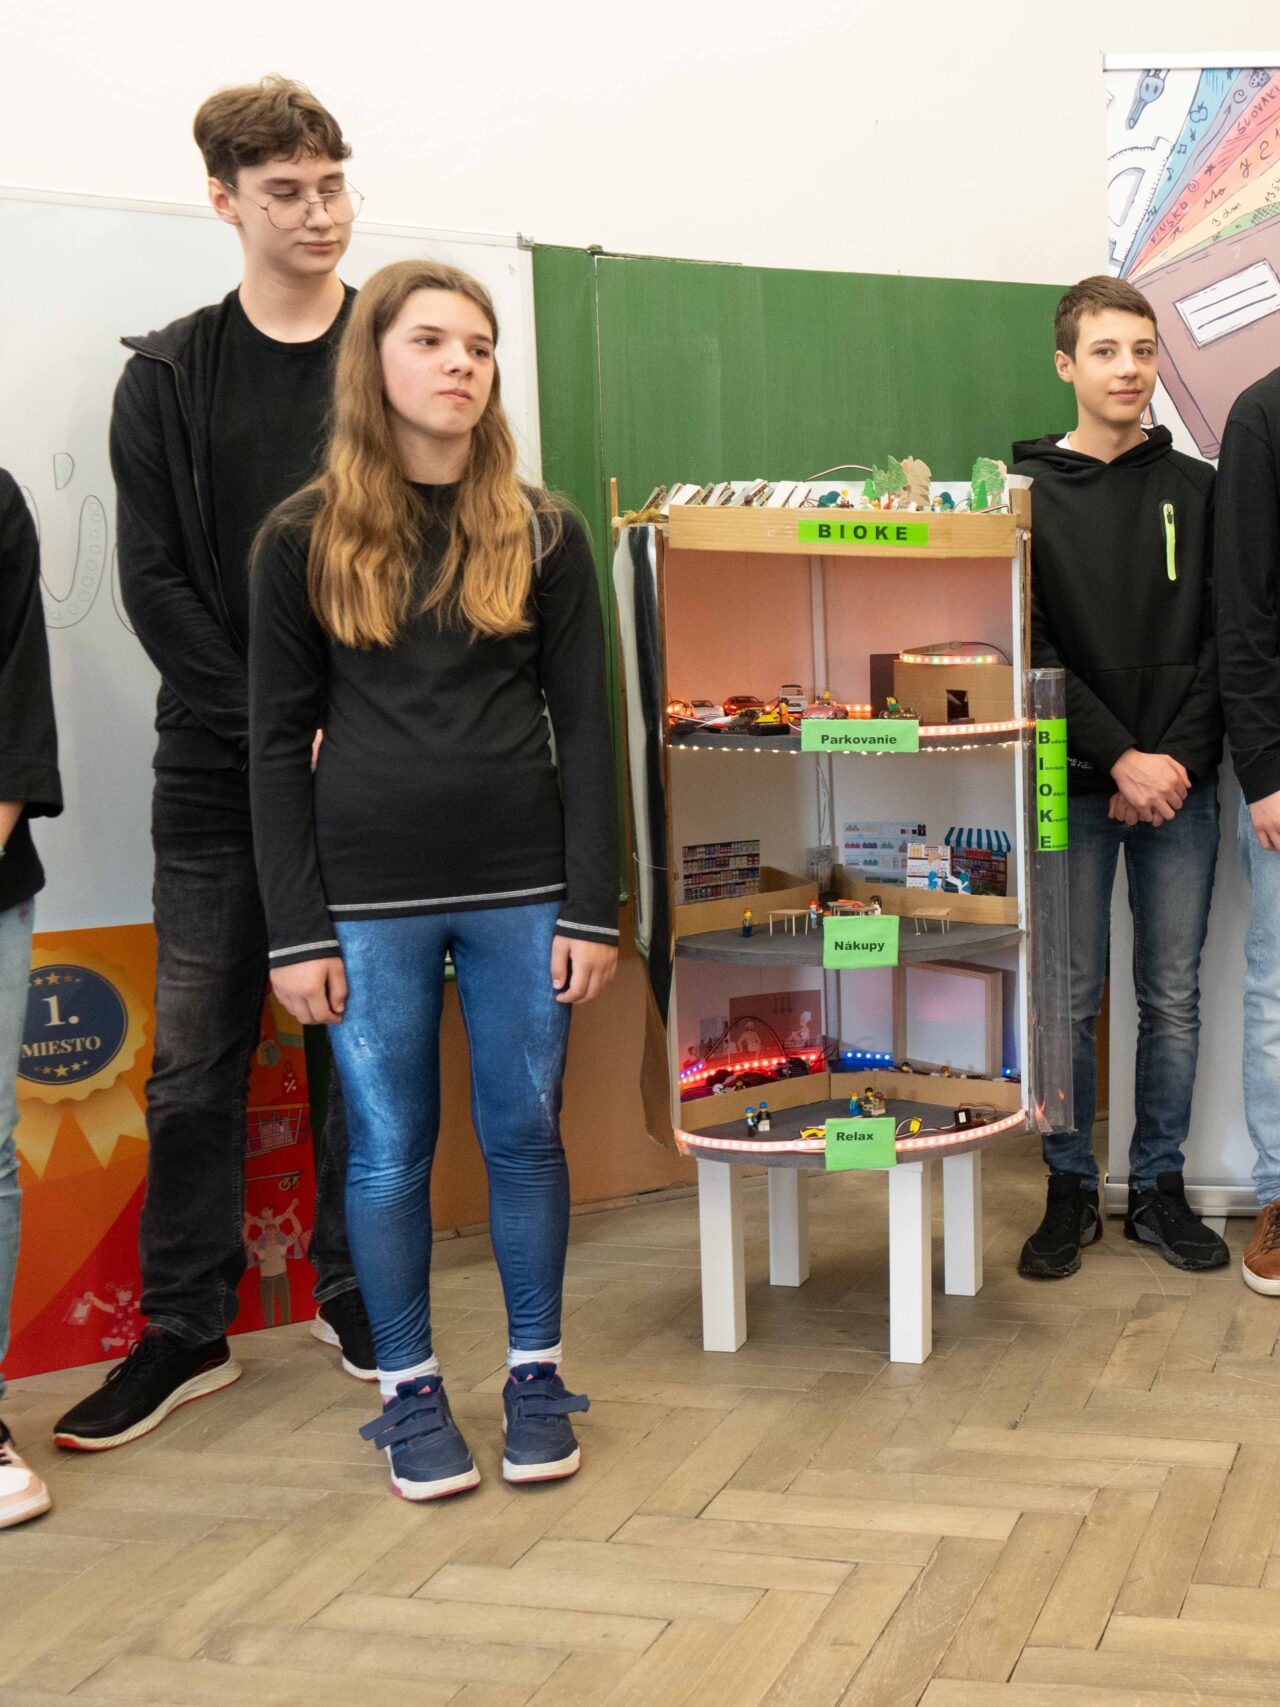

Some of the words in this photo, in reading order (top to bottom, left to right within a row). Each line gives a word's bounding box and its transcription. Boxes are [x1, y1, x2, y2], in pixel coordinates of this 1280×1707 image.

[818, 523, 908, 541] BIOKE
[820, 734, 897, 745] Parkovanie
[834, 940, 885, 953] Nákupy
[41, 994, 80, 1027] 1.
[21, 1036, 102, 1058] MIESTO
[836, 1131, 874, 1141] Relax
